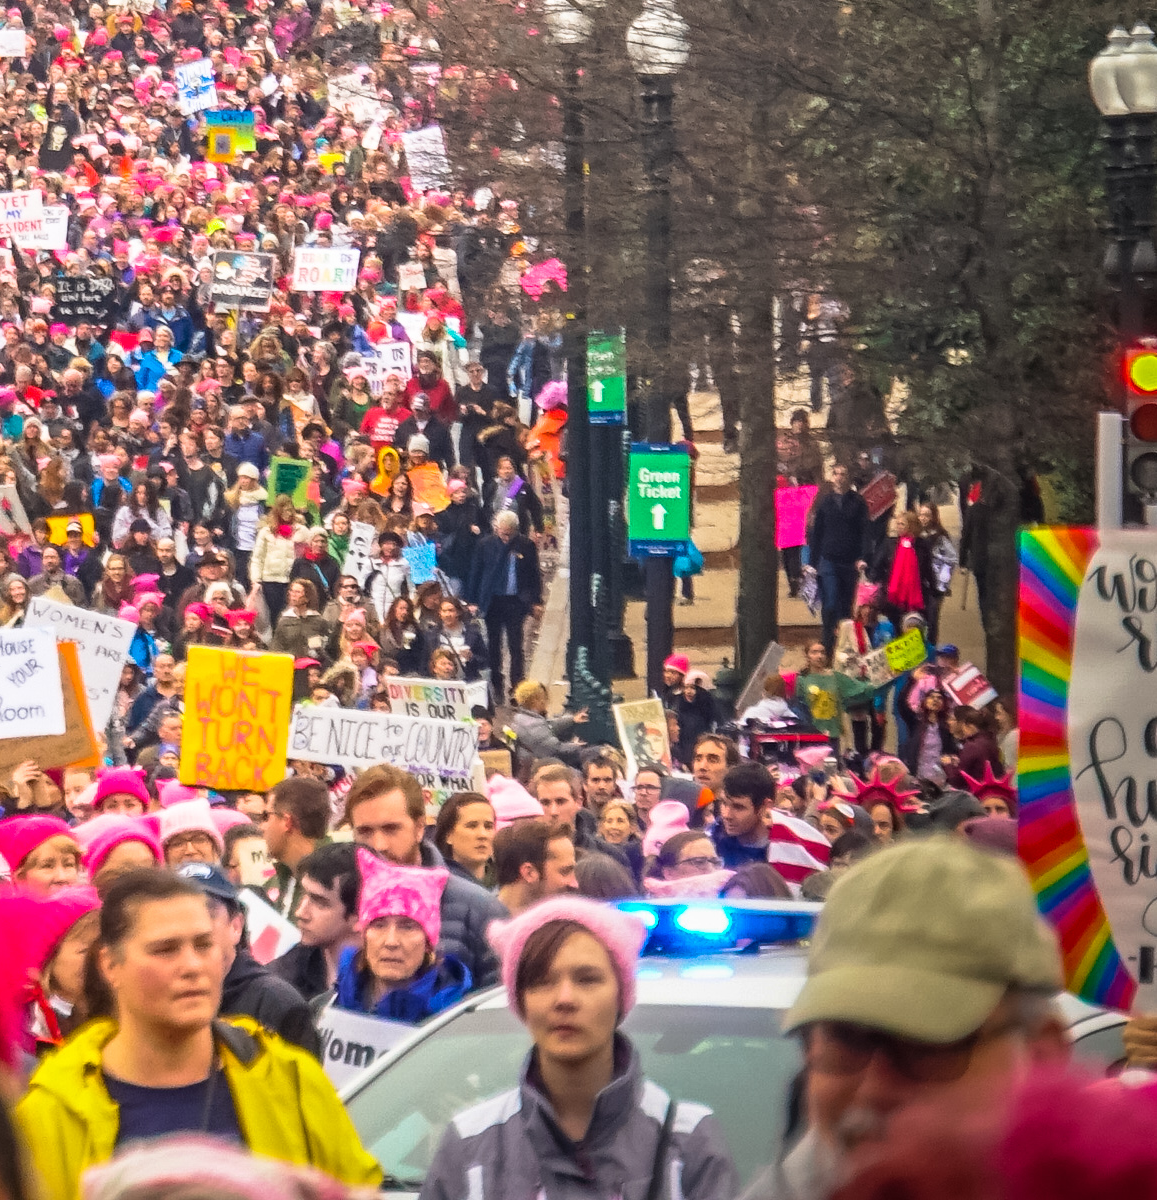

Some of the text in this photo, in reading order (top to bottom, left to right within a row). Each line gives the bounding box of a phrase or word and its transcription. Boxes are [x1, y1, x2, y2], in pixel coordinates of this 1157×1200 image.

[6, 209, 21, 219] MY
[637, 467, 681, 485] Green
[637, 483, 682, 500] Ticket
[32, 601, 123, 639] WOMEN'S
[5, 658, 45, 689] YOUR
[220, 655, 261, 687] WE
[195, 681, 282, 725] WONT
[388, 684, 466, 704] DIVERSITY
[405, 702, 457, 720] IS OUR
[198, 716, 276, 756] TURN
[292, 711, 322, 753] BE
[327, 716, 381, 762] NICE
[384, 716, 404, 738] to
[404, 721, 479, 770] COUNTRY
[195, 752, 272, 791] BACK
